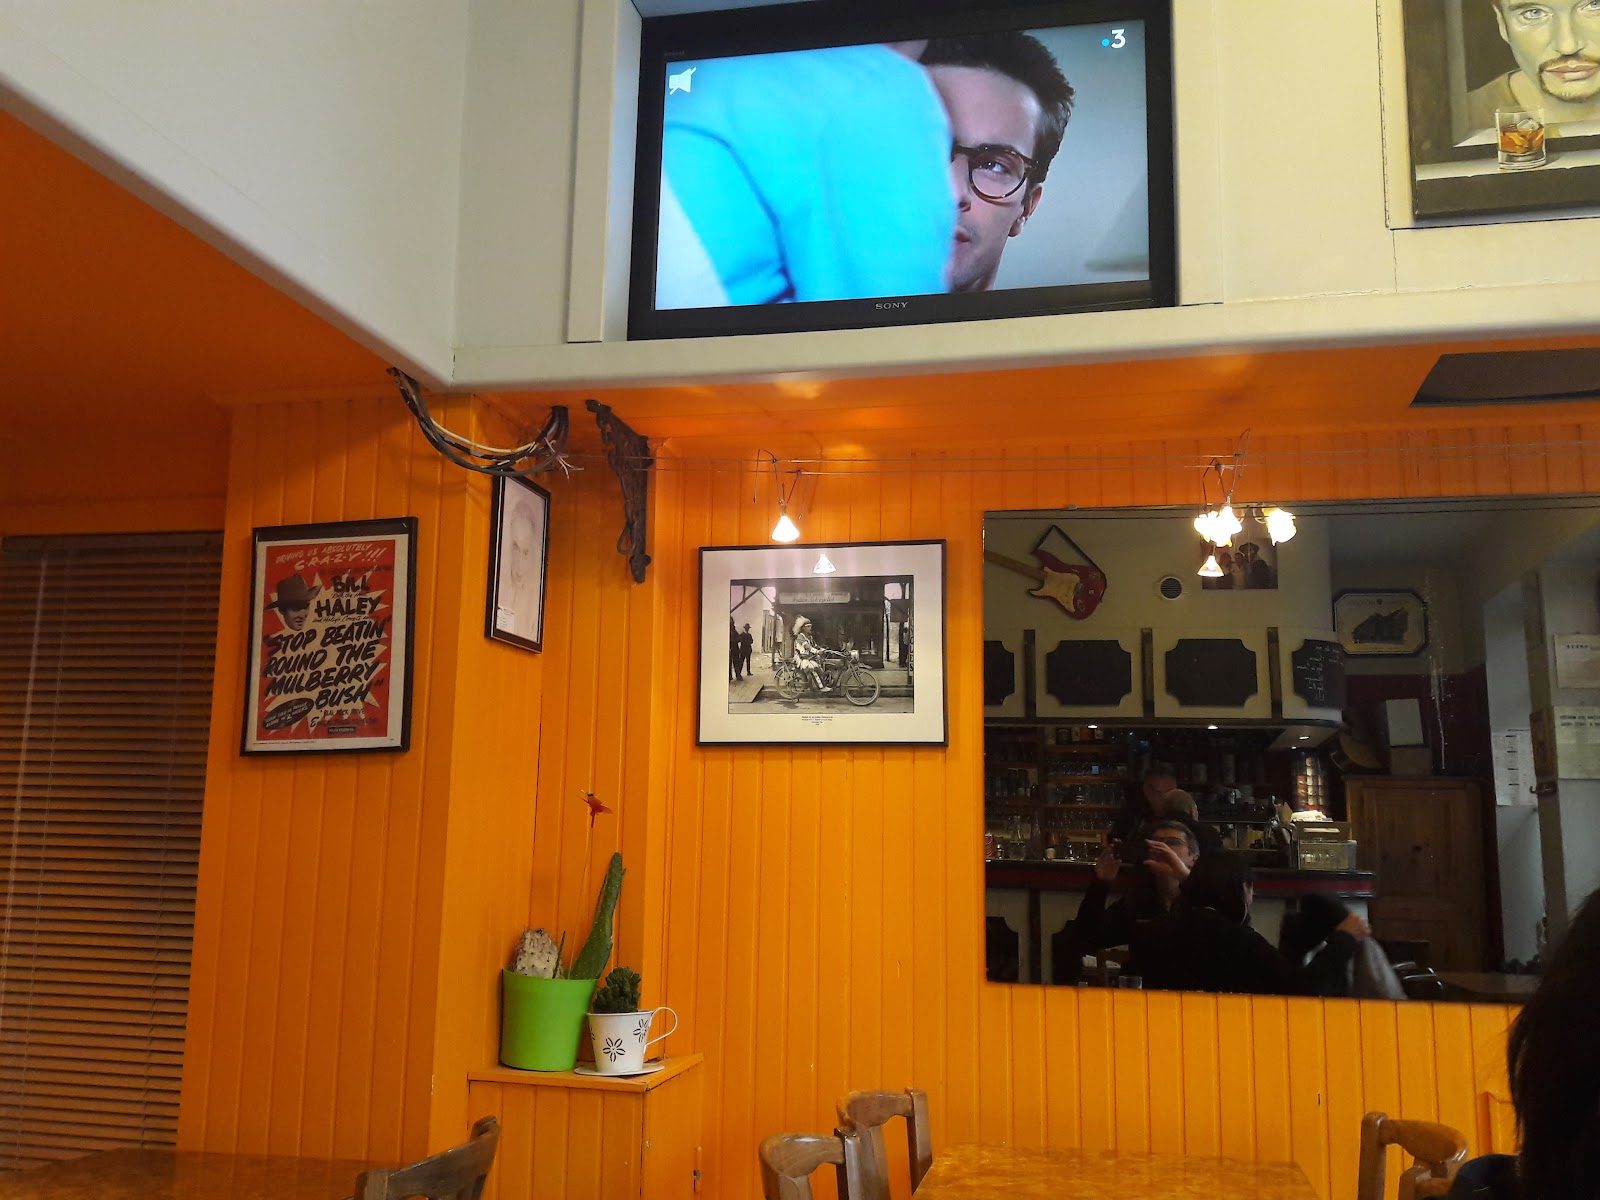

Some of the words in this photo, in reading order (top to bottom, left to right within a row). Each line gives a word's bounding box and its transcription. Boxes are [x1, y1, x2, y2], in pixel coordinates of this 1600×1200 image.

[1111, 29, 1126, 49] 3
[875, 301, 909, 310] SONY
[321, 543, 373, 554] ABSOLUTELY
[332, 574, 370, 593] BILL
[315, 595, 382, 617] HALEY
[264, 649, 328, 677] ROUND
[336, 639, 380, 666] THE
[264, 661, 381, 697] MULBERRY
